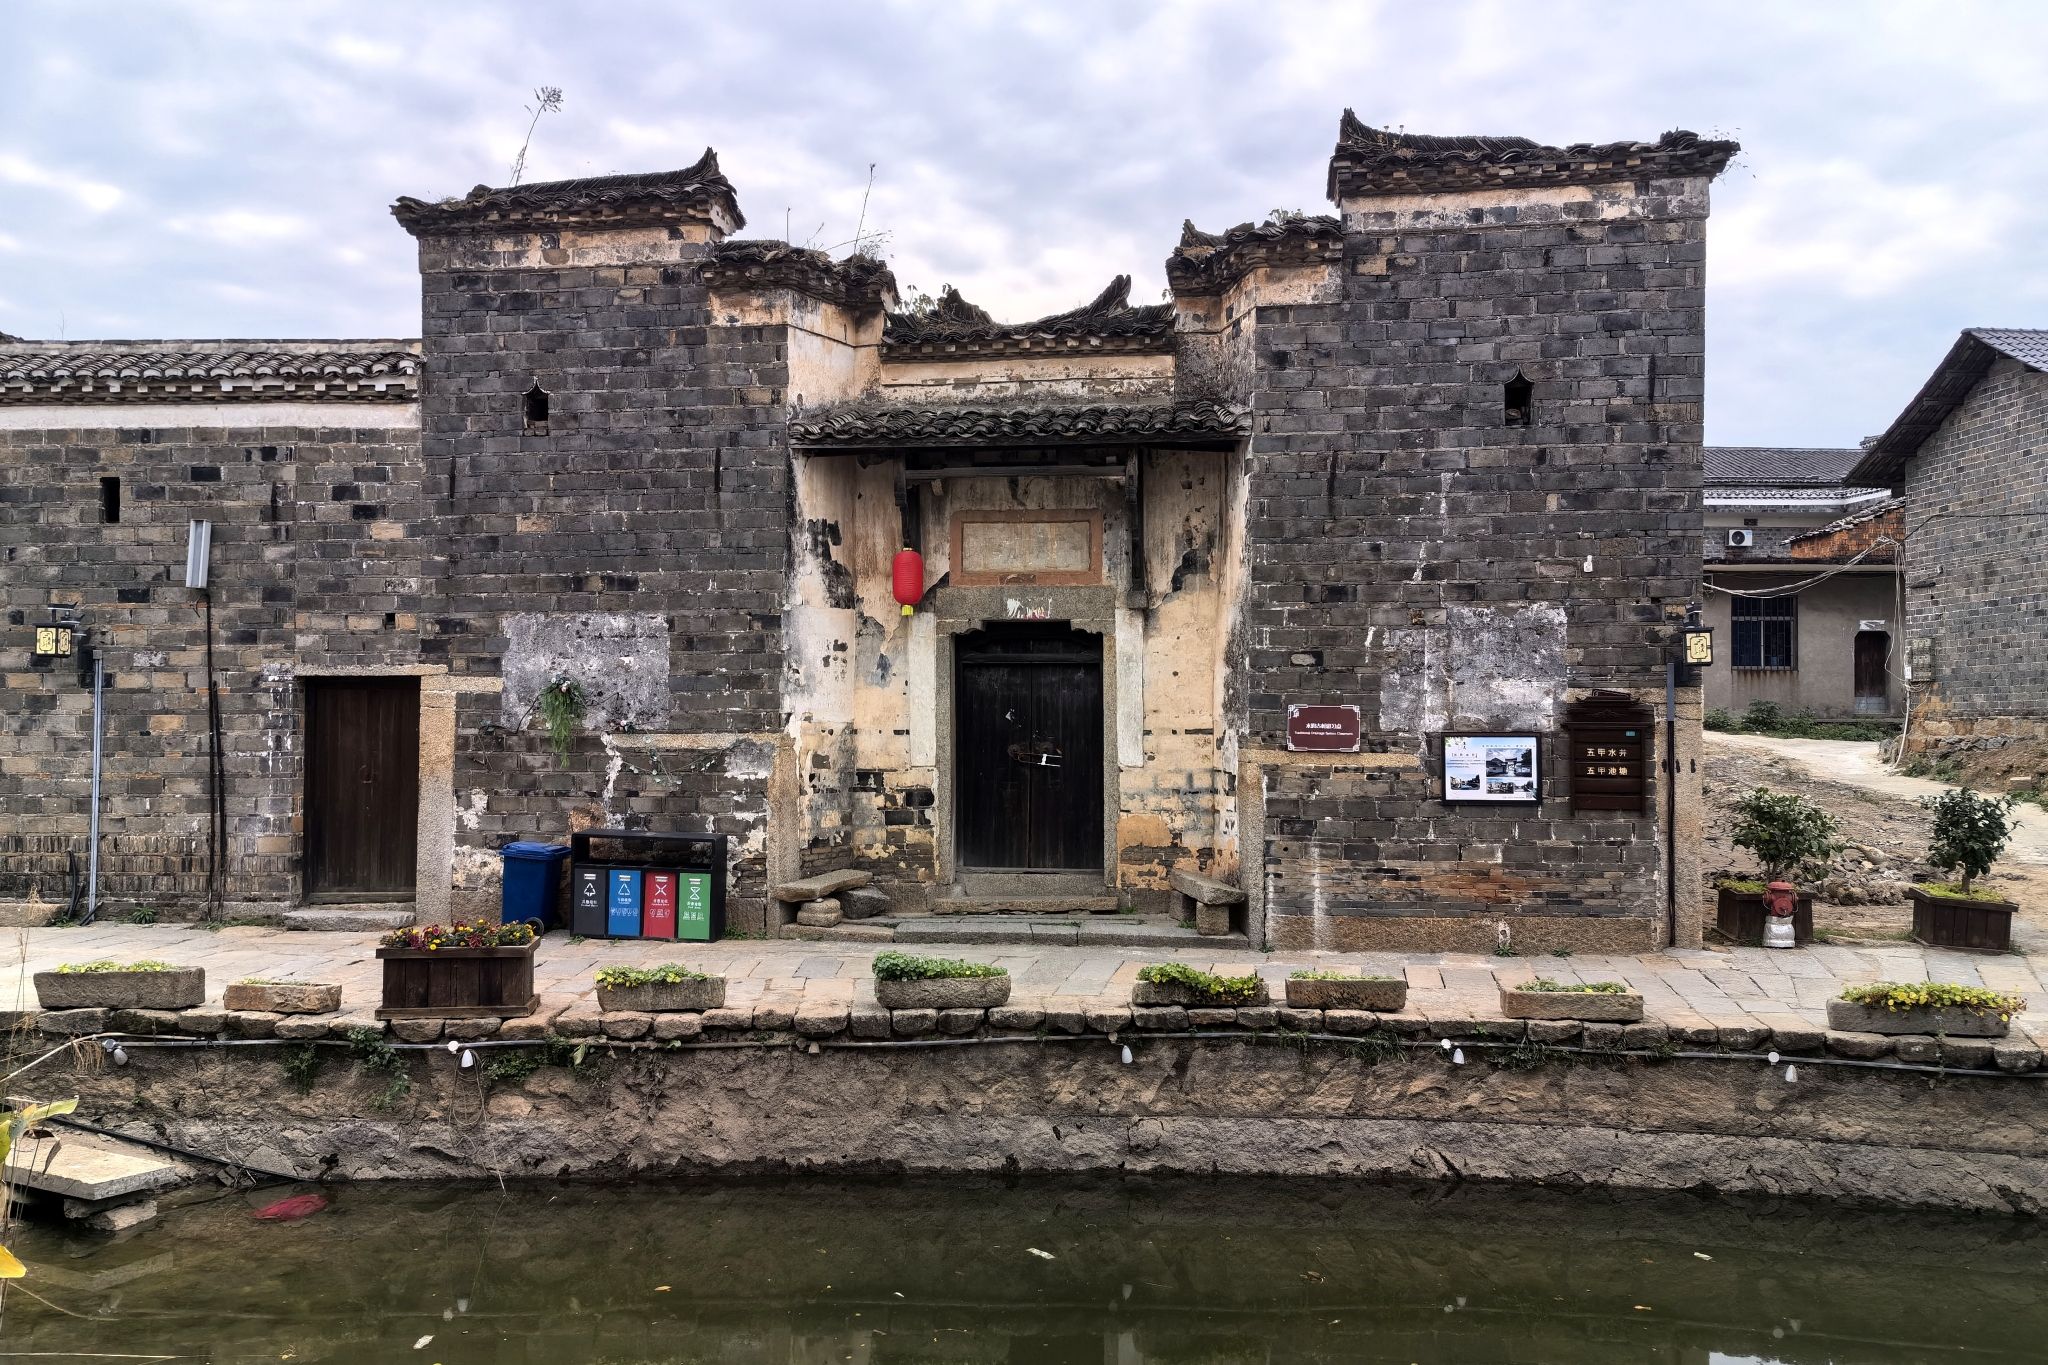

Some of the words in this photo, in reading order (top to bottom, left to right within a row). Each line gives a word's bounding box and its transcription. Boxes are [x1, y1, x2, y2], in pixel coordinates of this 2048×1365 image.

[1586, 748, 1627, 757] 五甲水井
[1586, 766, 1627, 775] 五甲池塘
